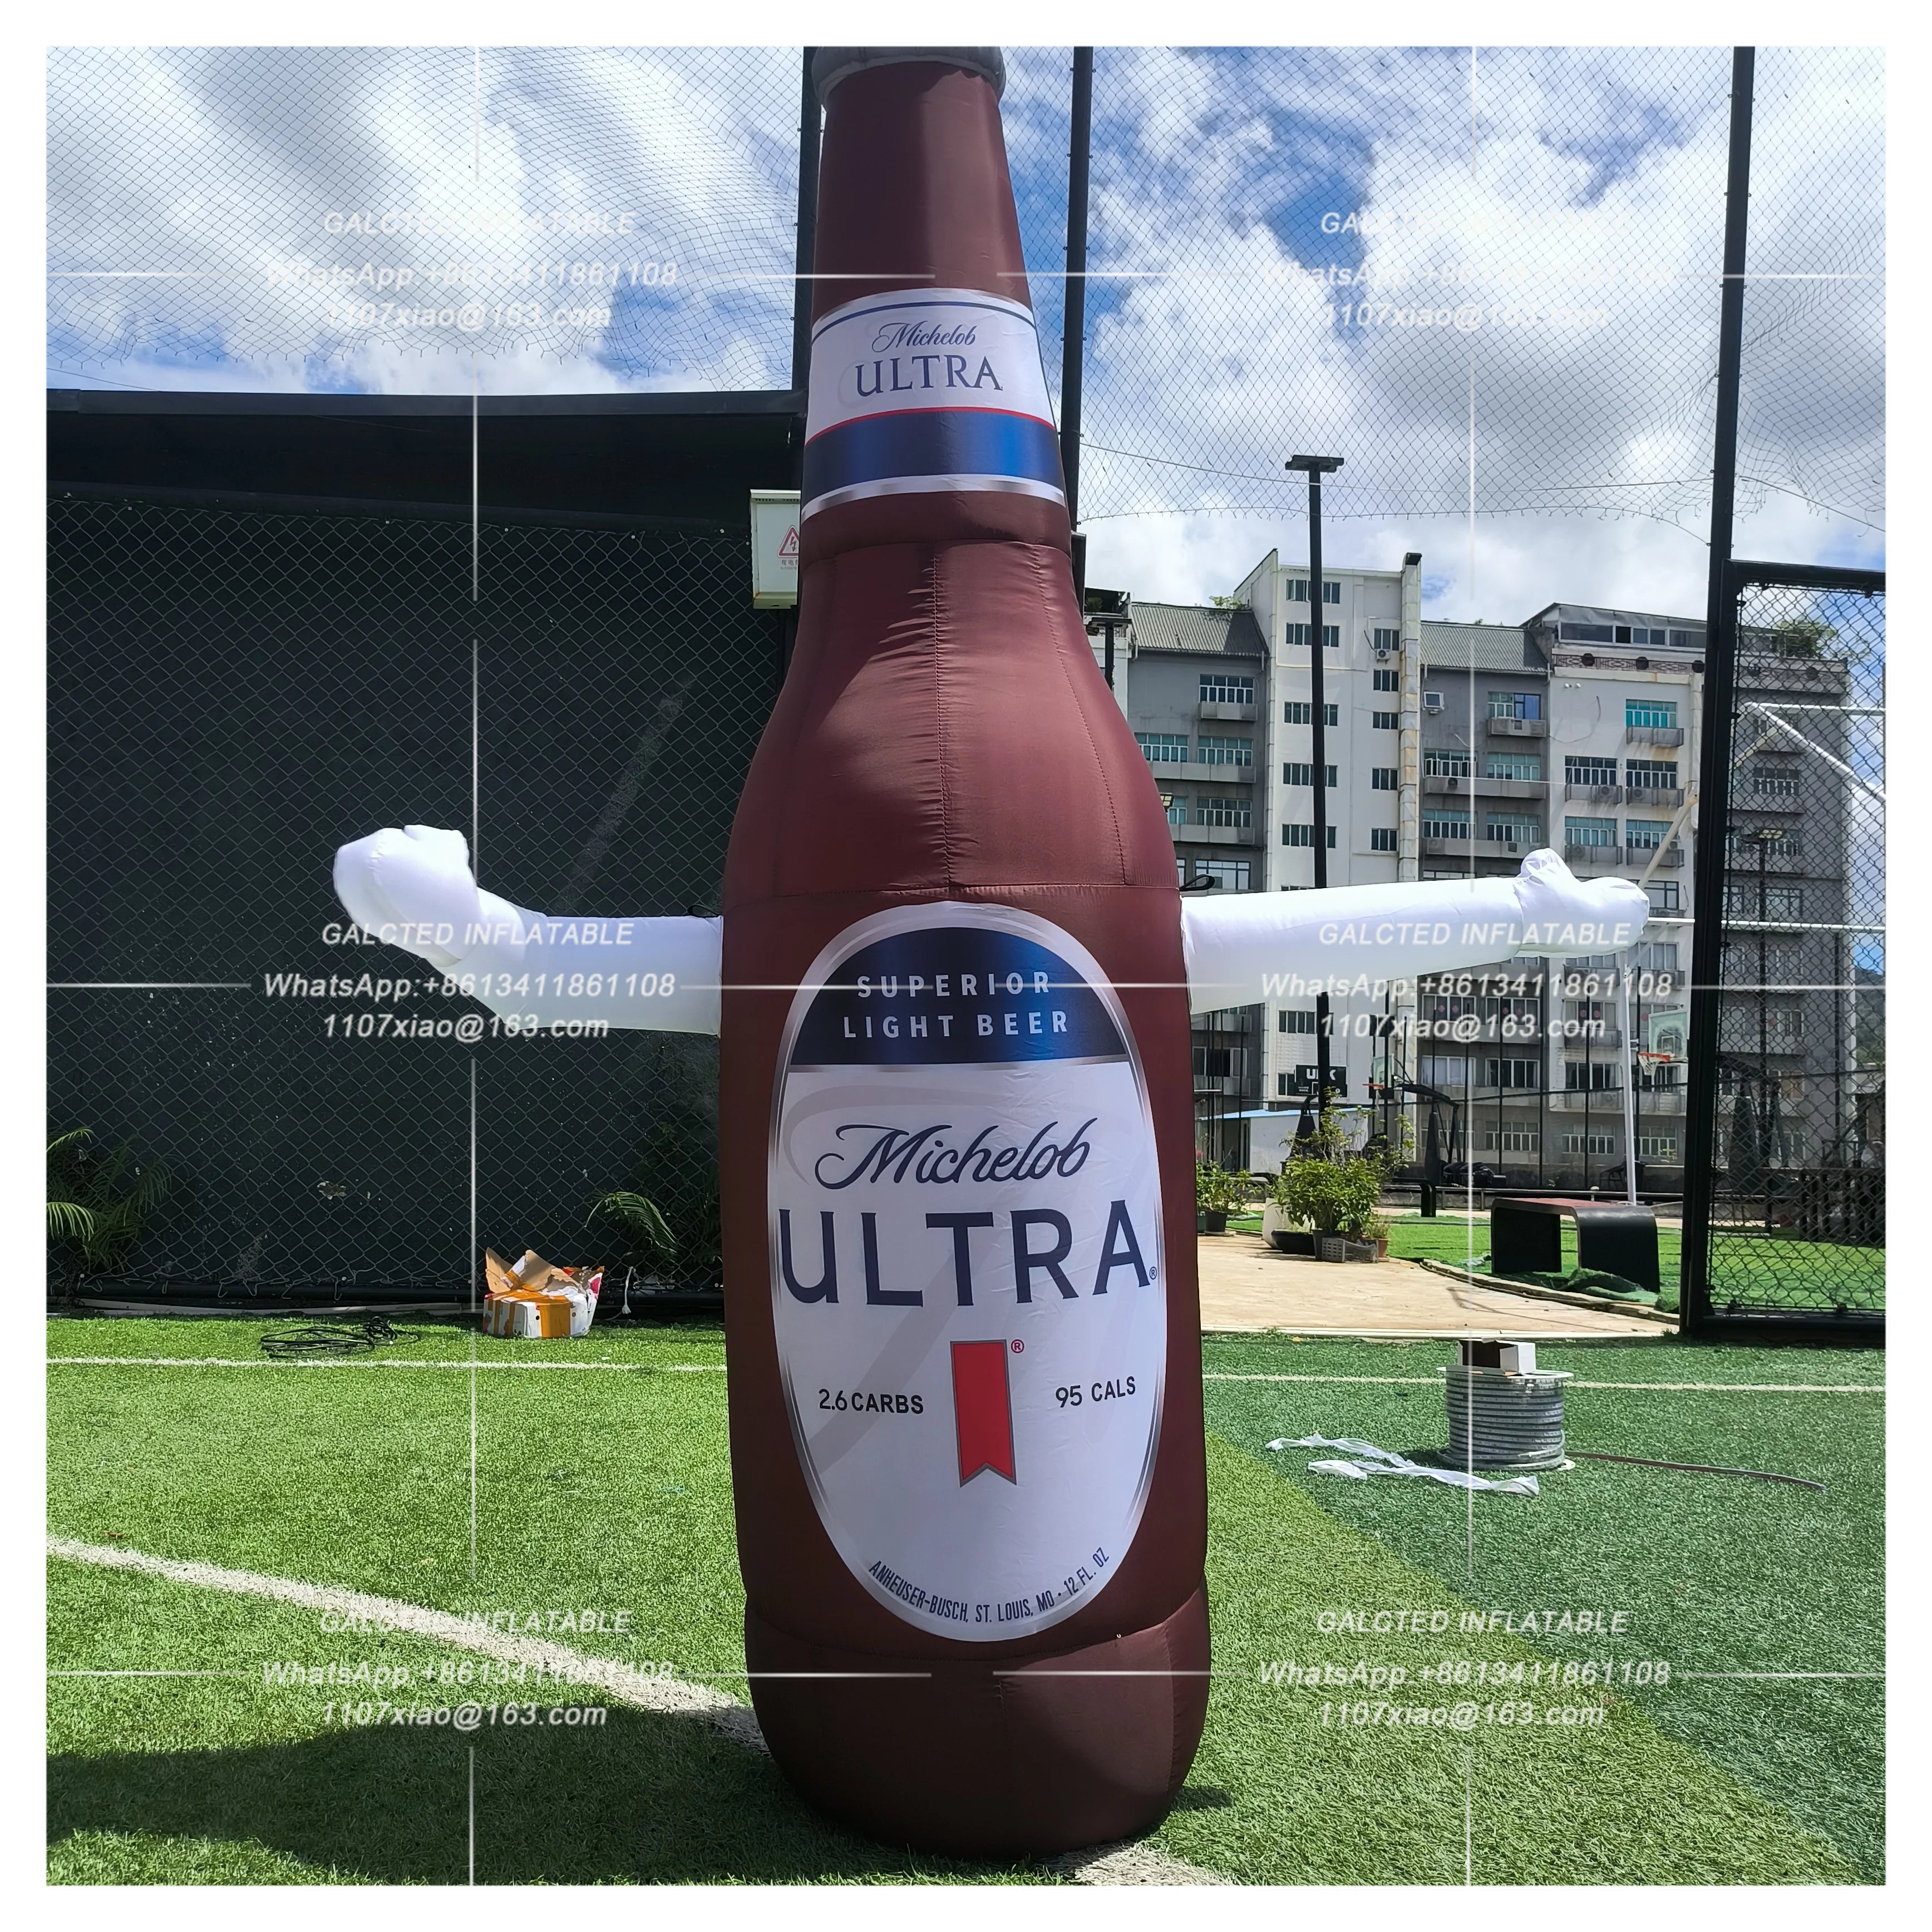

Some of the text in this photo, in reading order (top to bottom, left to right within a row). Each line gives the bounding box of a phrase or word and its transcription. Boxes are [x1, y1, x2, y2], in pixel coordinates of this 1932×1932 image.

[872, 321, 977, 353] Michelob
[855, 354, 1003, 397] ULTRA
[857, 971, 1049, 998] SUPERIOR
[844, 1011, 1068, 1038] LIGHT BEER
[815, 1117, 1098, 1190] Michelob
[1055, 1376, 1136, 1408] 95 CALS
[868, 1547, 1110, 1623] ANHEUSER-BUSCH, ST. LOUIS, MO 12 FL. OZ
